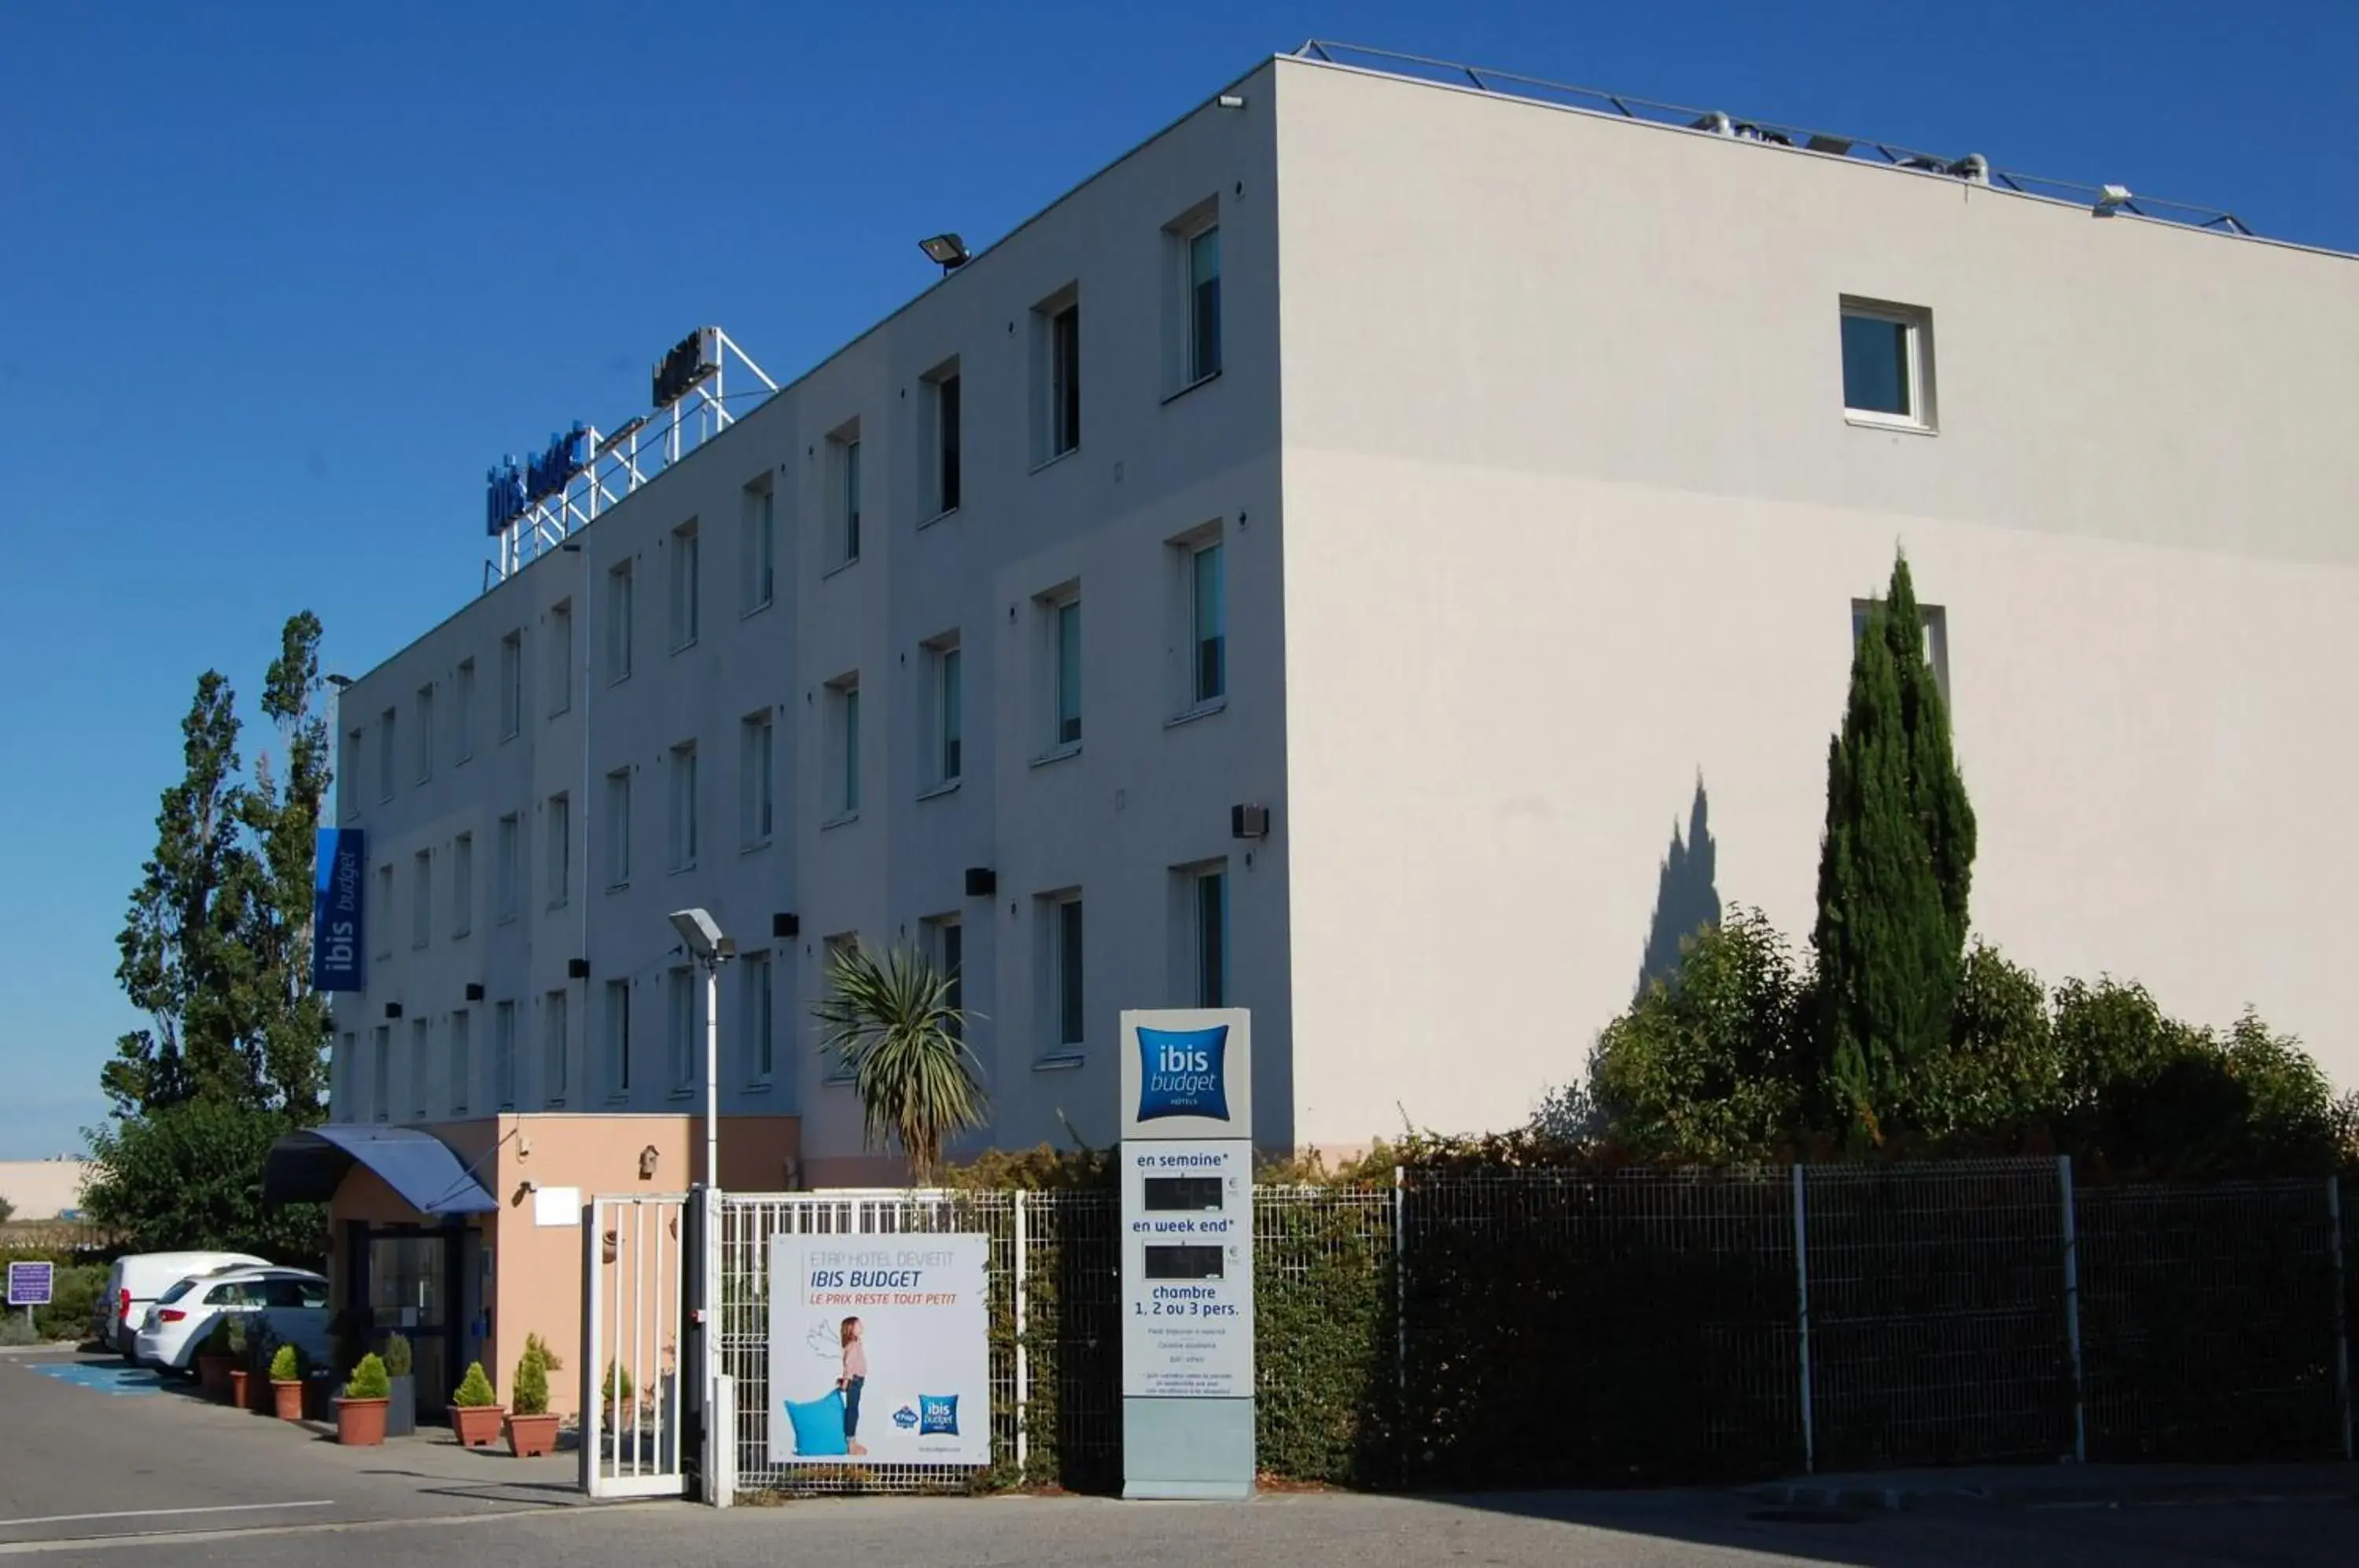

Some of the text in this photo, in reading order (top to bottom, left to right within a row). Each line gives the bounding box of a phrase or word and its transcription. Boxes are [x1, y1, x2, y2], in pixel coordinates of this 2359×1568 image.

[325, 852, 359, 970] ibis budget
[1159, 1045, 1209, 1072] ibis
[1150, 1072, 1216, 1095] budget
[1137, 1156, 1155, 1166] en
[1133, 1221, 1150, 1232] en
[1155, 1219, 1195, 1232] week
[811, 1270, 922, 1287] IBIS BUDGET
[810, 1294, 824, 1305] LE
[826, 1294, 852, 1305] PRIX
[855, 1294, 890, 1305] RESTE
[893, 1294, 923, 1305] TOUT
[1153, 1286, 1216, 1299] chambre
[1153, 1302, 1161, 1315] 2
[1166, 1305, 1184, 1316] ou
[1190, 1302, 1198, 1315] 3
[1203, 1304, 1239, 1317] pers.
[928, 1401, 951, 1415] ibis
